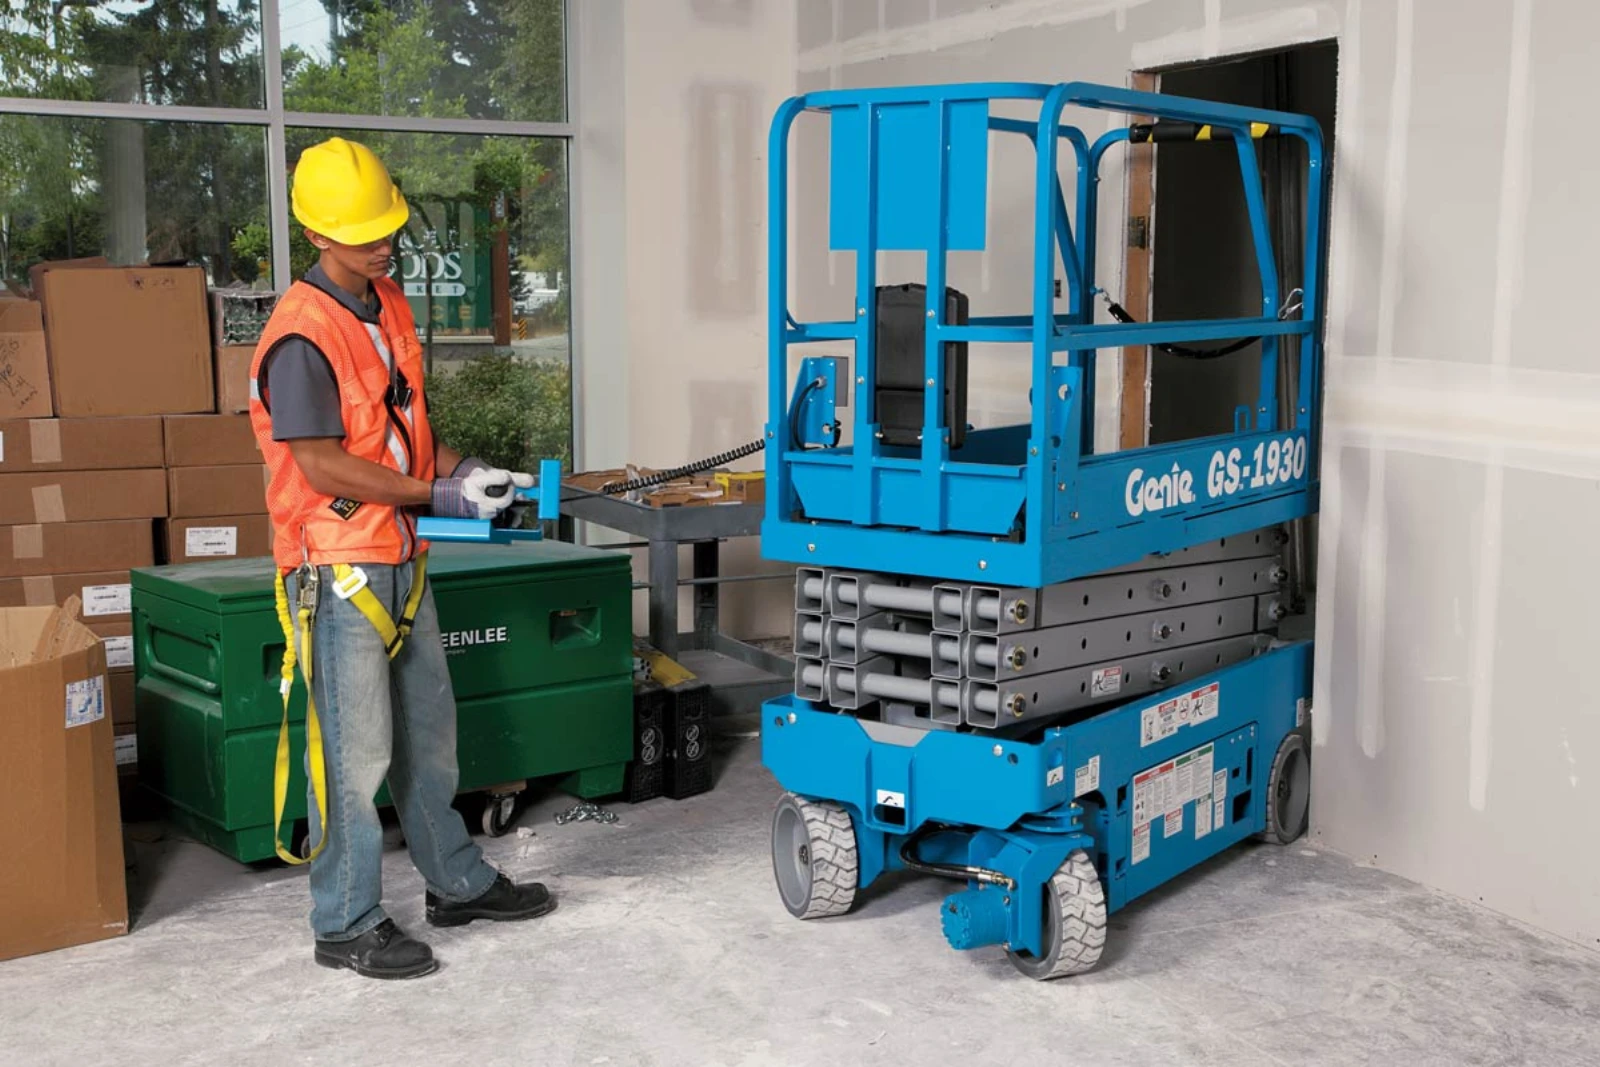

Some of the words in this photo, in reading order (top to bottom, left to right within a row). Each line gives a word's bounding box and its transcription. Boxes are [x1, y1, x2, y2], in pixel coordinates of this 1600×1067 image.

[388, 252, 462, 279] ODS
[1125, 461, 1194, 517] Genie
[1207, 436, 1306, 498] GS-1930
